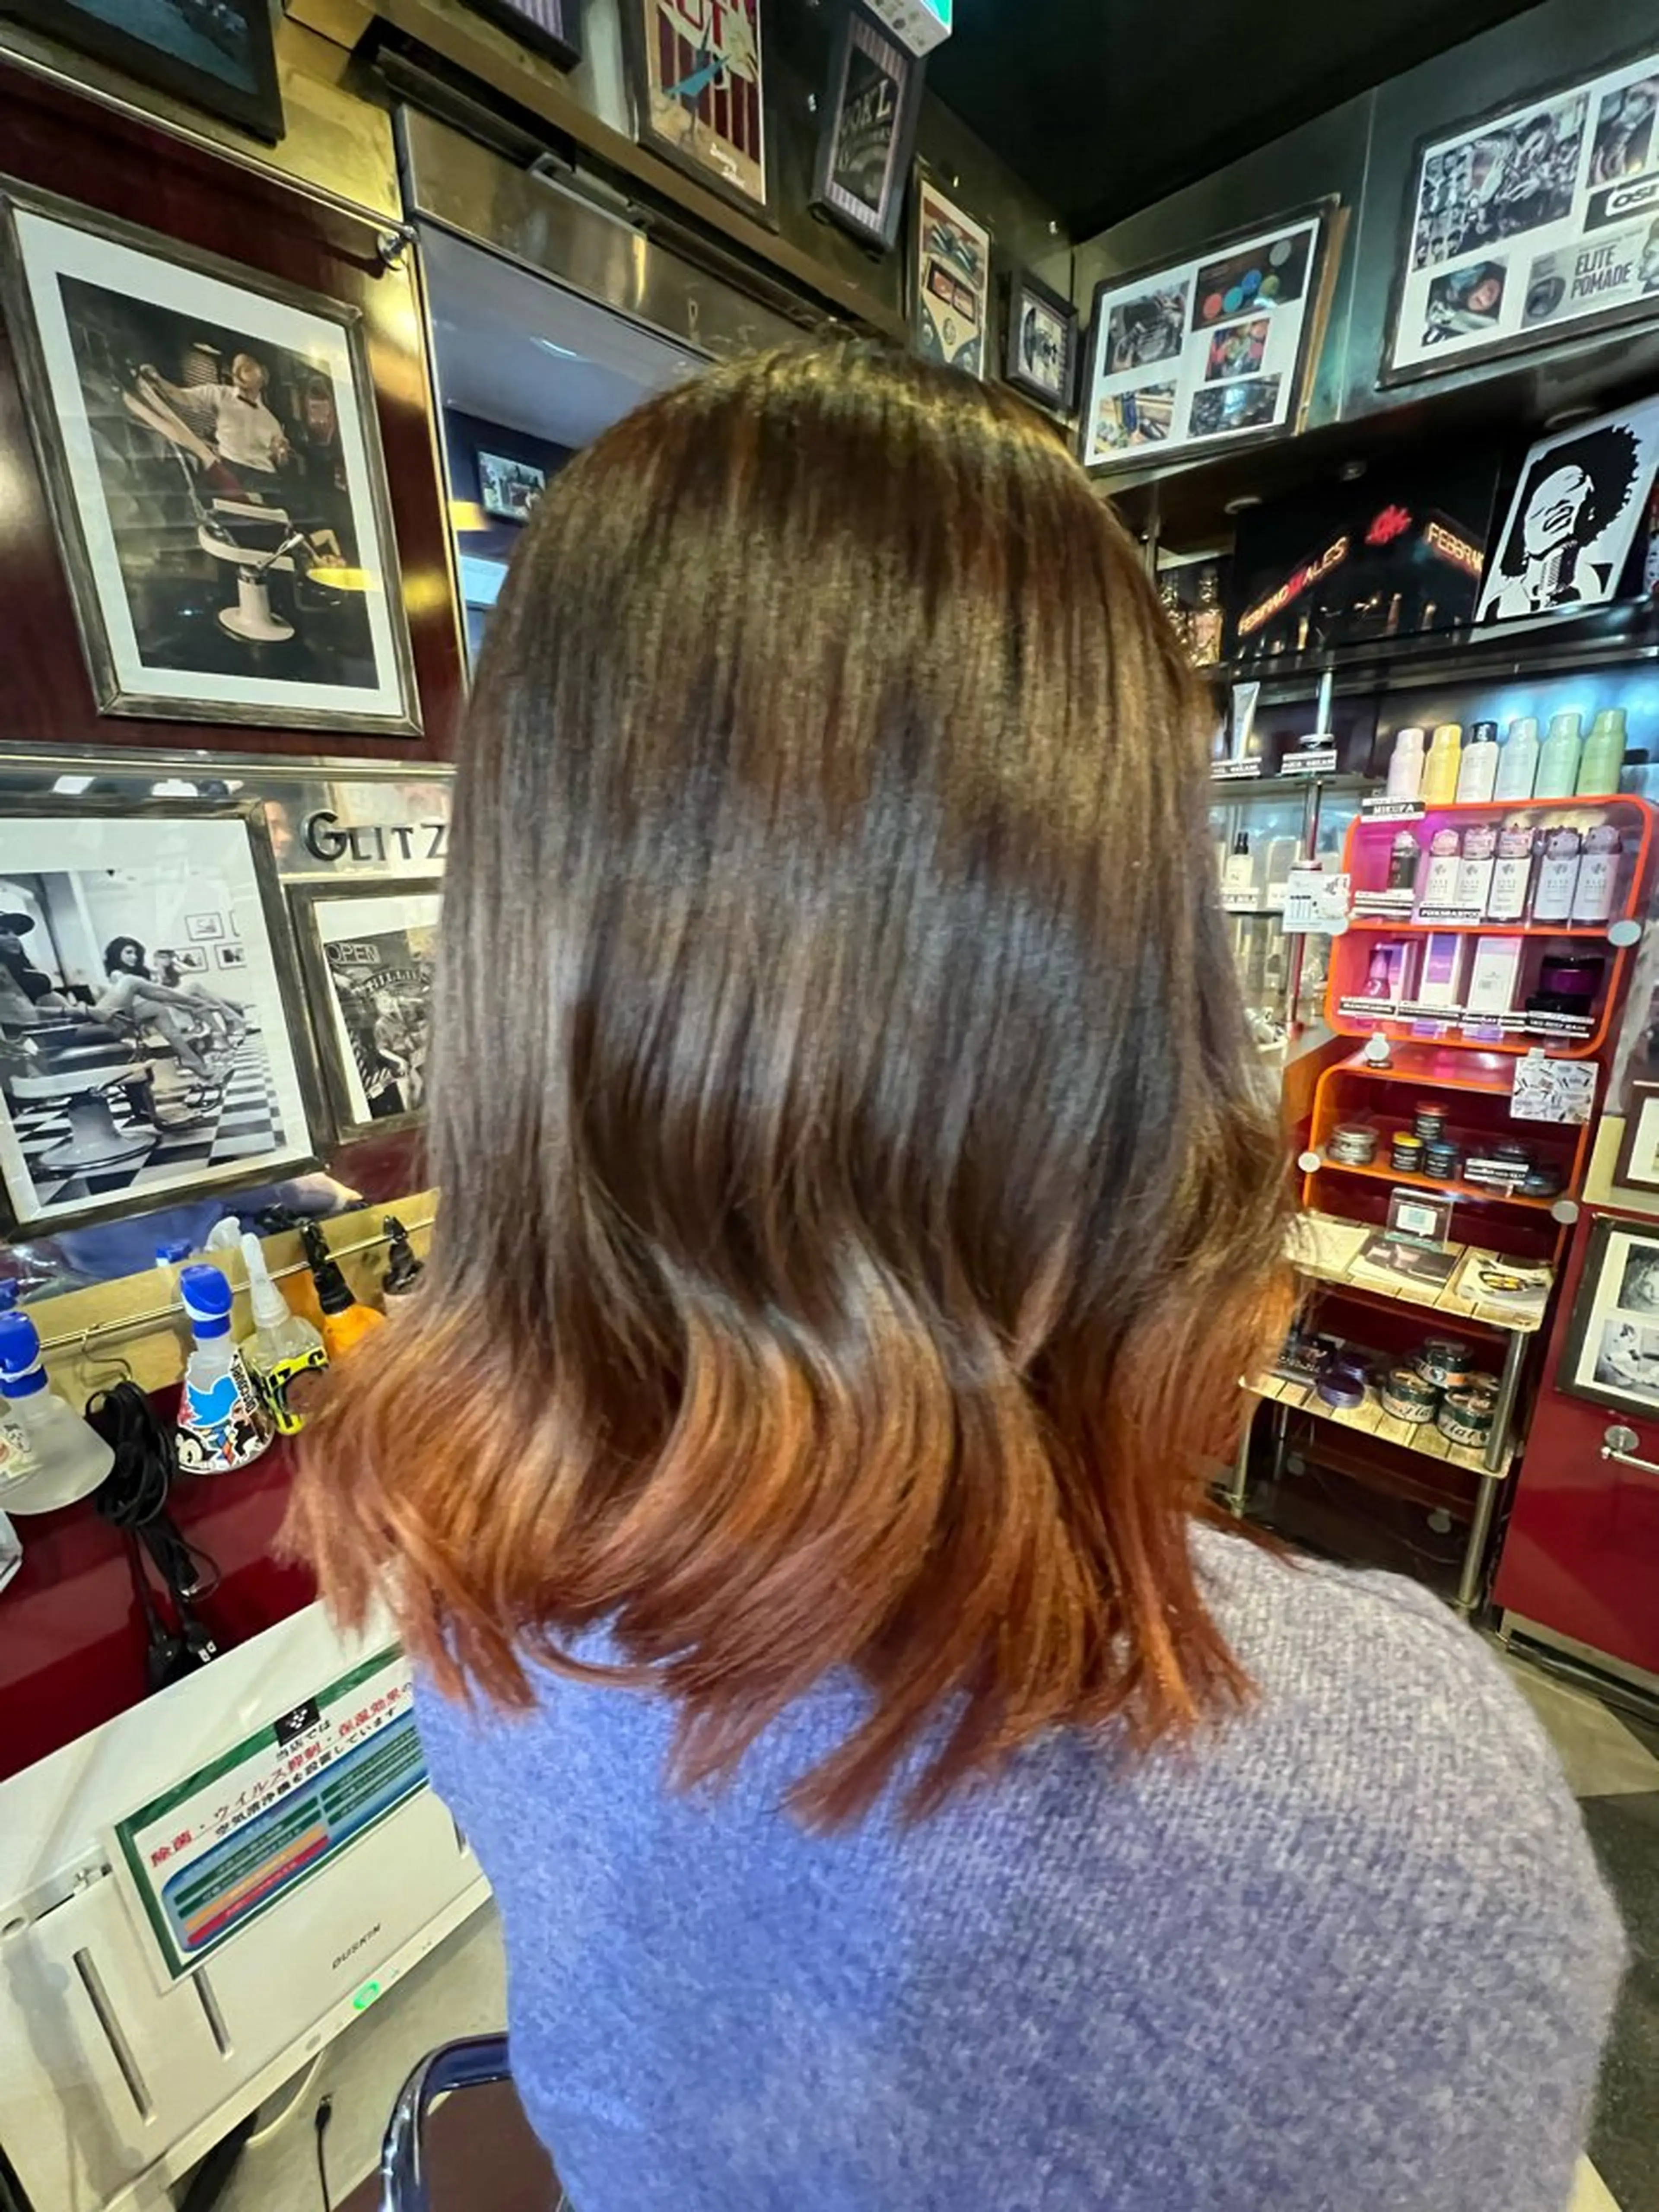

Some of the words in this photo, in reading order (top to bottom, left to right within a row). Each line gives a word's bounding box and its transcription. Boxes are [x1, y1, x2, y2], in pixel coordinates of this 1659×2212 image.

[1571, 261, 1633, 299] POMADE
[1575, 244, 1617, 276] ELITE
[305, 810, 447, 861] GLITZ
[325, 943, 379, 965] OPEN
[276, 1720, 331, 1761] 当店では
[216, 1707, 397, 1836] 空気清浄機を設置しています
[332, 1923, 381, 1970] DUSKIN
